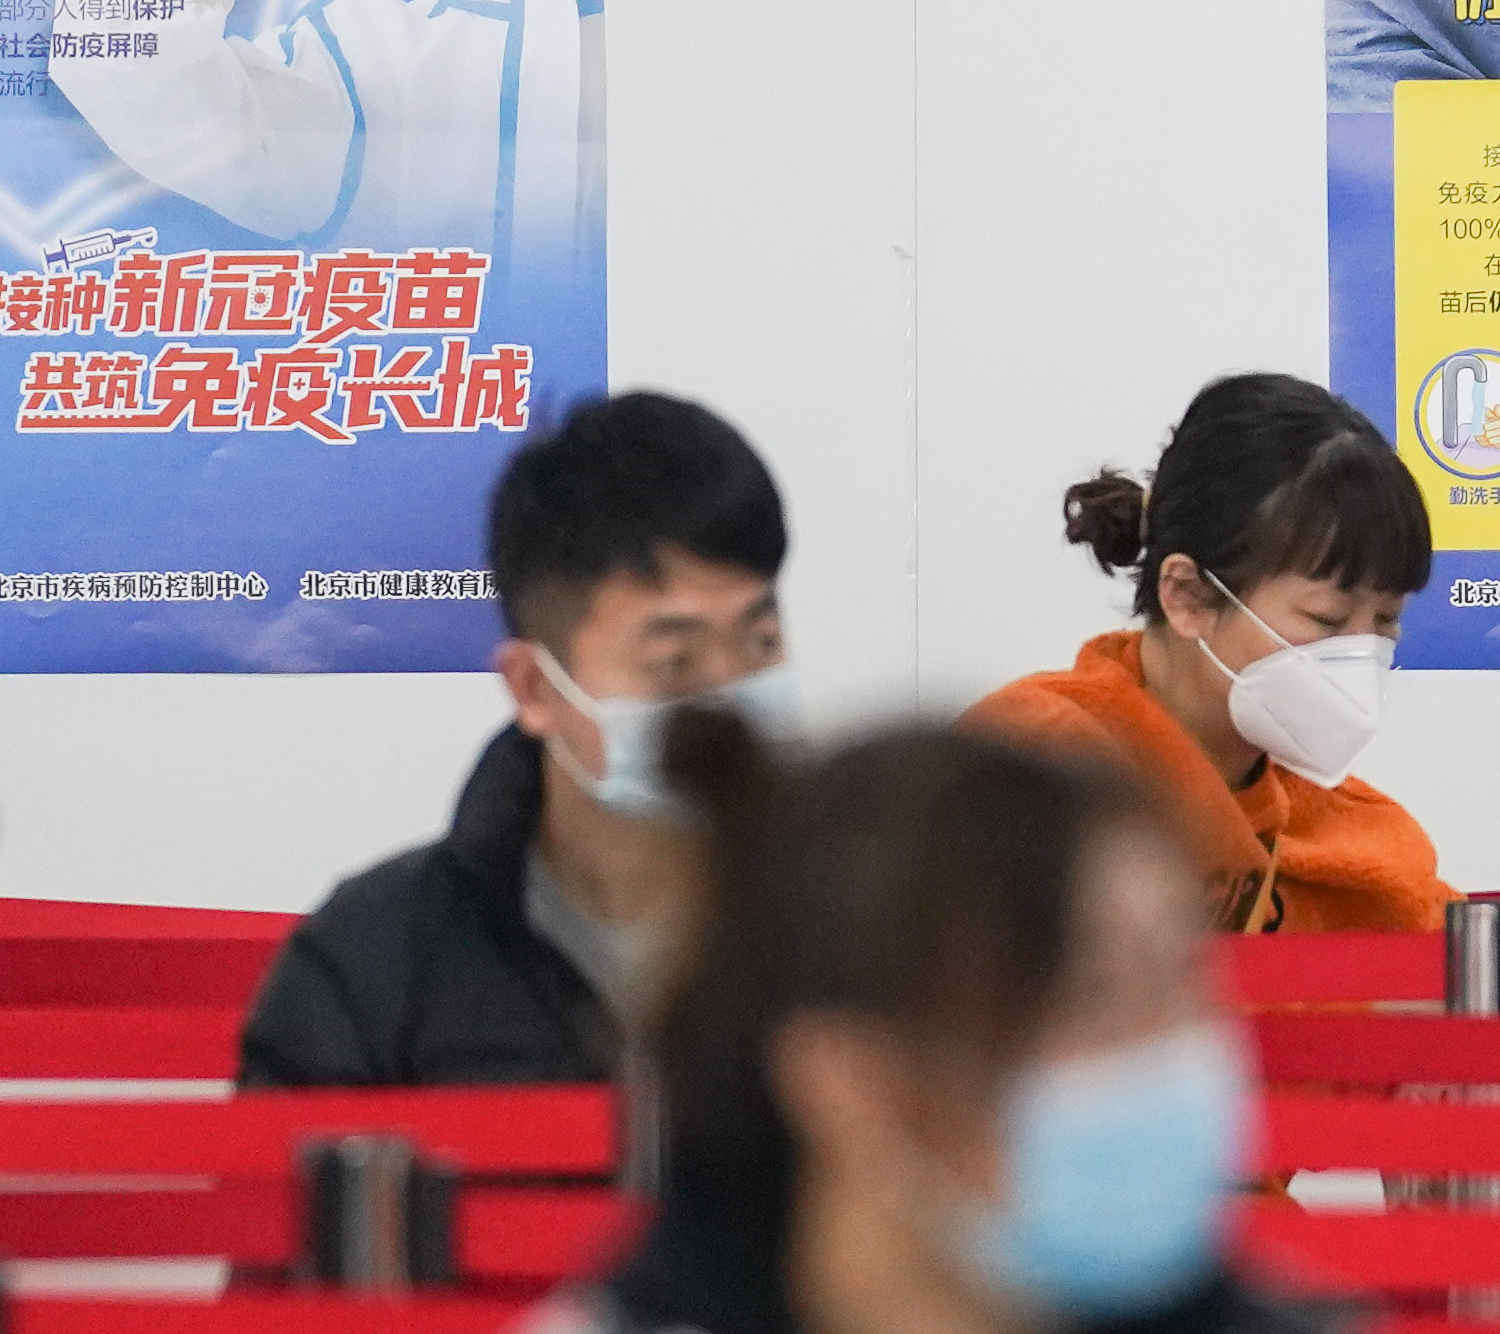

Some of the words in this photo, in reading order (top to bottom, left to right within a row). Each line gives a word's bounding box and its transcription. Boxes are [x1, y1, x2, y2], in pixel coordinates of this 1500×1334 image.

[16, 337, 534, 445] 共筑免疫长城
